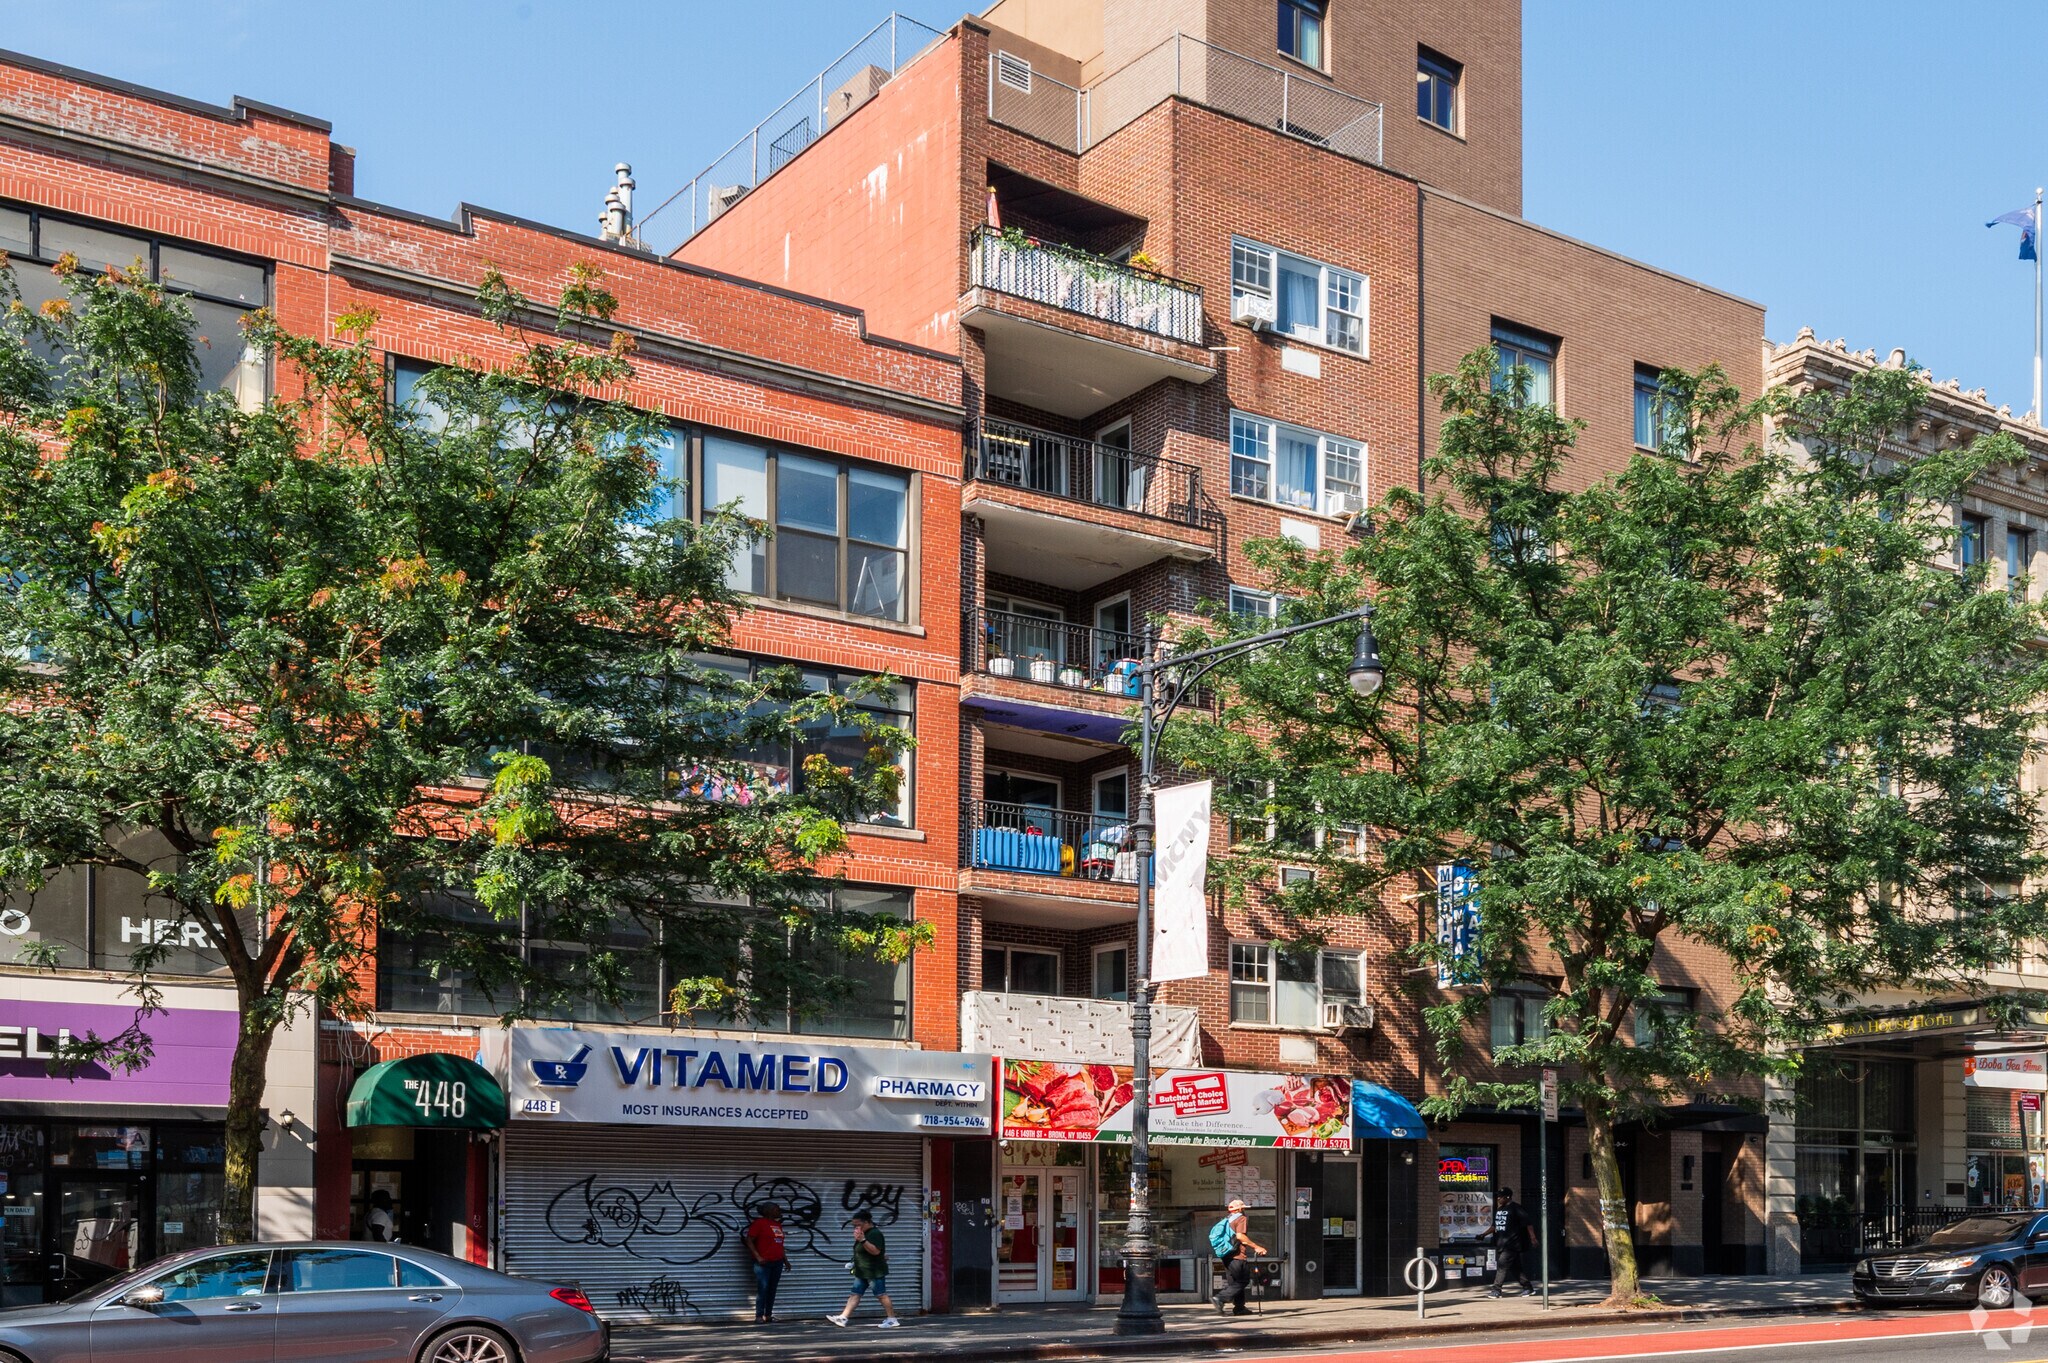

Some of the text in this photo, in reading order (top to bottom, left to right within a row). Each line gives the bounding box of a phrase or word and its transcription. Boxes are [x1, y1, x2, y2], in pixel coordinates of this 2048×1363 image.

[1868, 1016, 1909, 1033] HOUSE
[1912, 1014, 1955, 1028] HOTEL
[609, 1046, 849, 1093] VITAMED
[1979, 1057, 2043, 1072] Boba Tea Time
[880, 1080, 980, 1097] PHARMACY
[404, 1080, 466, 1118] THE 448
[1159, 1090, 1224, 1103] Butcher's Choice
[1197, 1097, 1224, 1106] Market
[525, 1100, 556, 1111] 448 E
[623, 1104, 808, 1120] MOST INSURANCES ACCEPTED
[925, 1115, 985, 1126] 718-954-9494
[1155, 1118, 1166, 1126] We
[1168, 1119, 1189, 1127] Make
[1003, 1129, 1015, 1137] 446
[1283, 1138, 1348, 1149] Tel: 718 402 5378
[1438, 1160, 1466, 1172] OPEN
[1457, 1193, 1487, 1202] PRIYA
